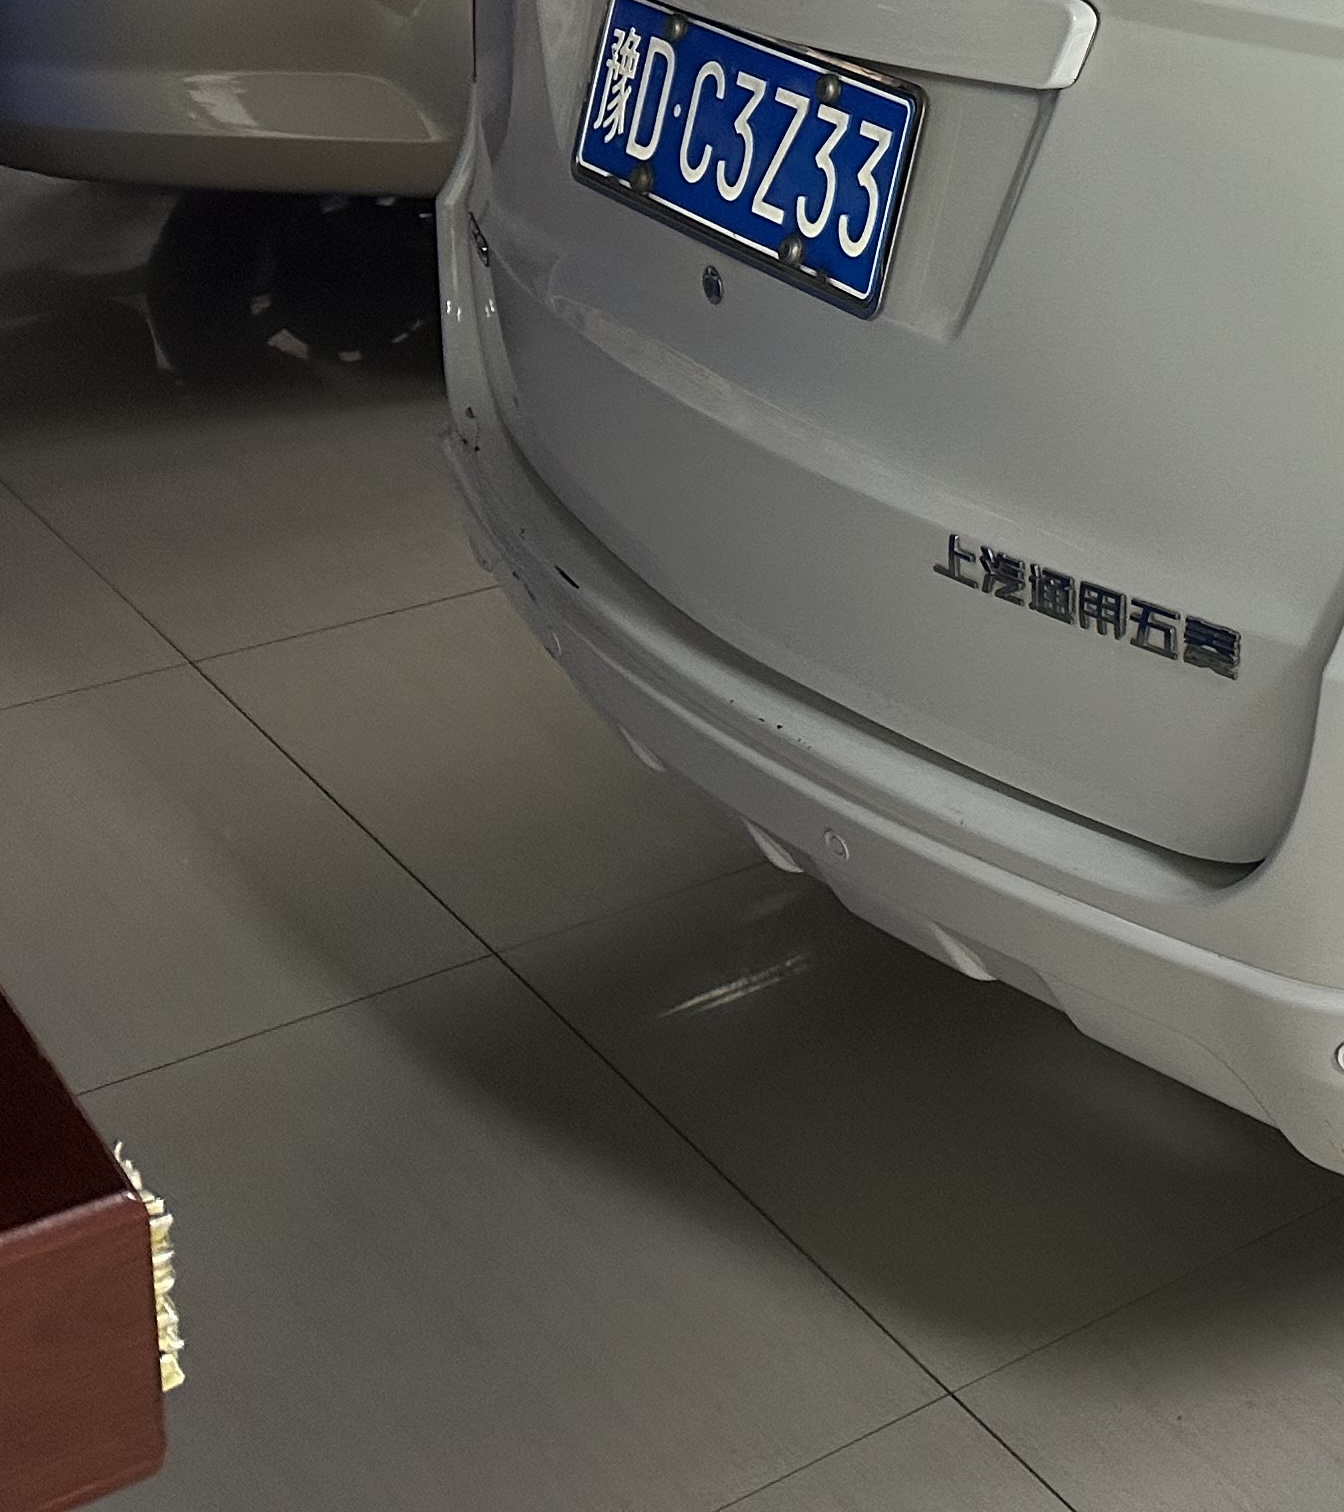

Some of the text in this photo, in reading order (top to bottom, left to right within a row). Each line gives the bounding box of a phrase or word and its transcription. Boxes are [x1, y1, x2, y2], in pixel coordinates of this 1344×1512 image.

[932, 534, 1242, 680] 上汽通用五菱
